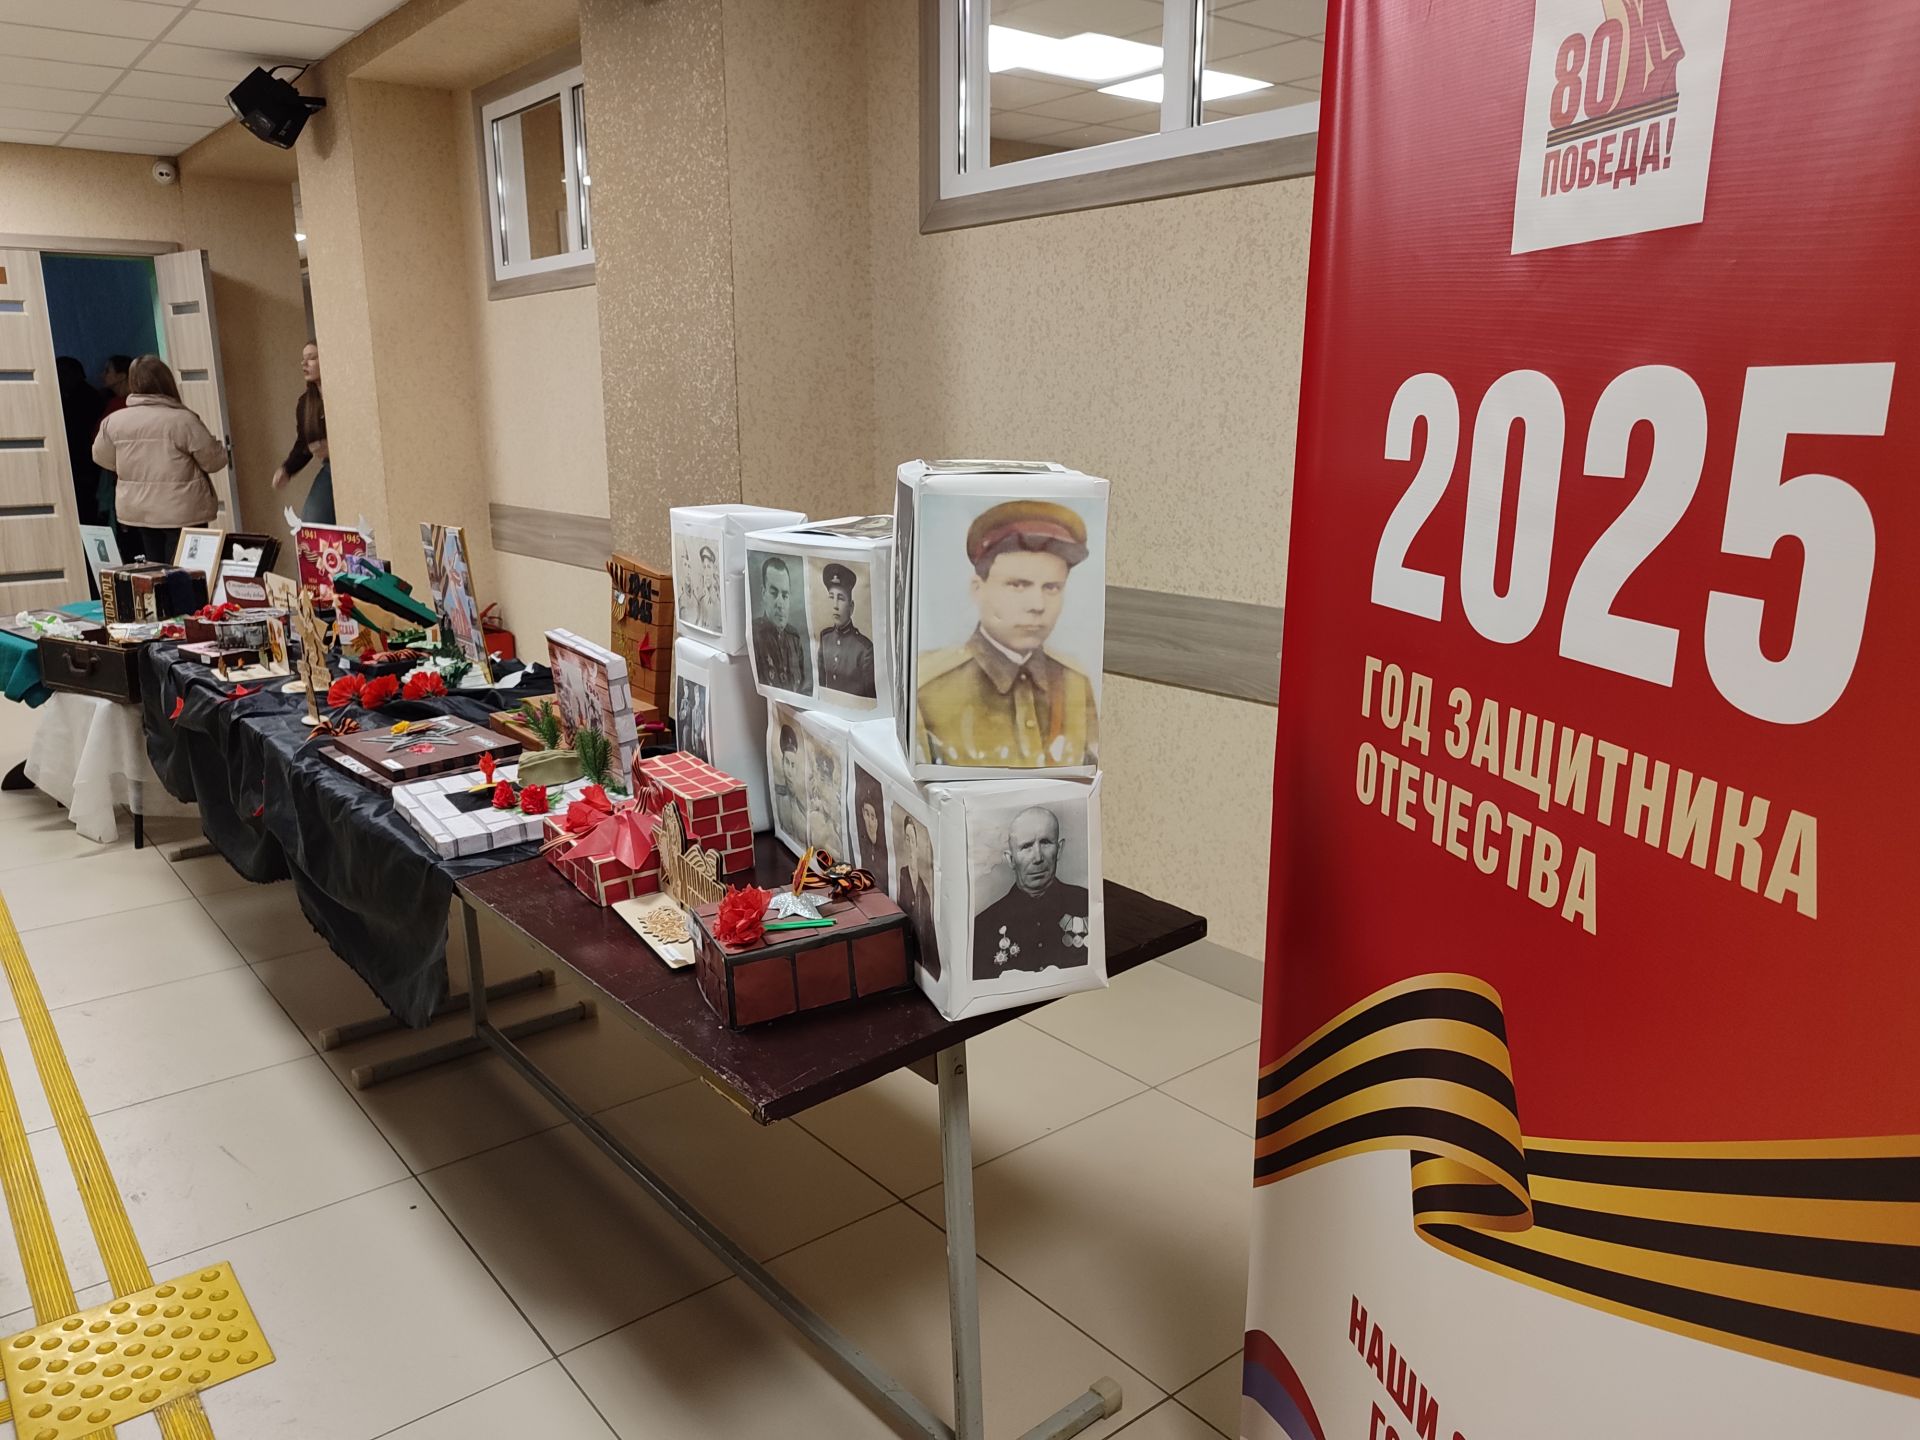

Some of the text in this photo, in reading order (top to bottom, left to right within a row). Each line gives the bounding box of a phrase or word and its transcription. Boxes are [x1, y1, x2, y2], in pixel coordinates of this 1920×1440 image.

[1549, 18, 1626, 129] 80
[1540, 116, 1676, 198] ПОБЕДА!
[301, 529, 361, 545] 1941 1945
[1371, 362, 1896, 725] 2025
[1356, 742, 1597, 935] ОТЕЧЕСТВА
[1361, 655, 1818, 920] ГОД ЗАЩИТНИКА
[1349, 1293, 1439, 1440] НАШИ
